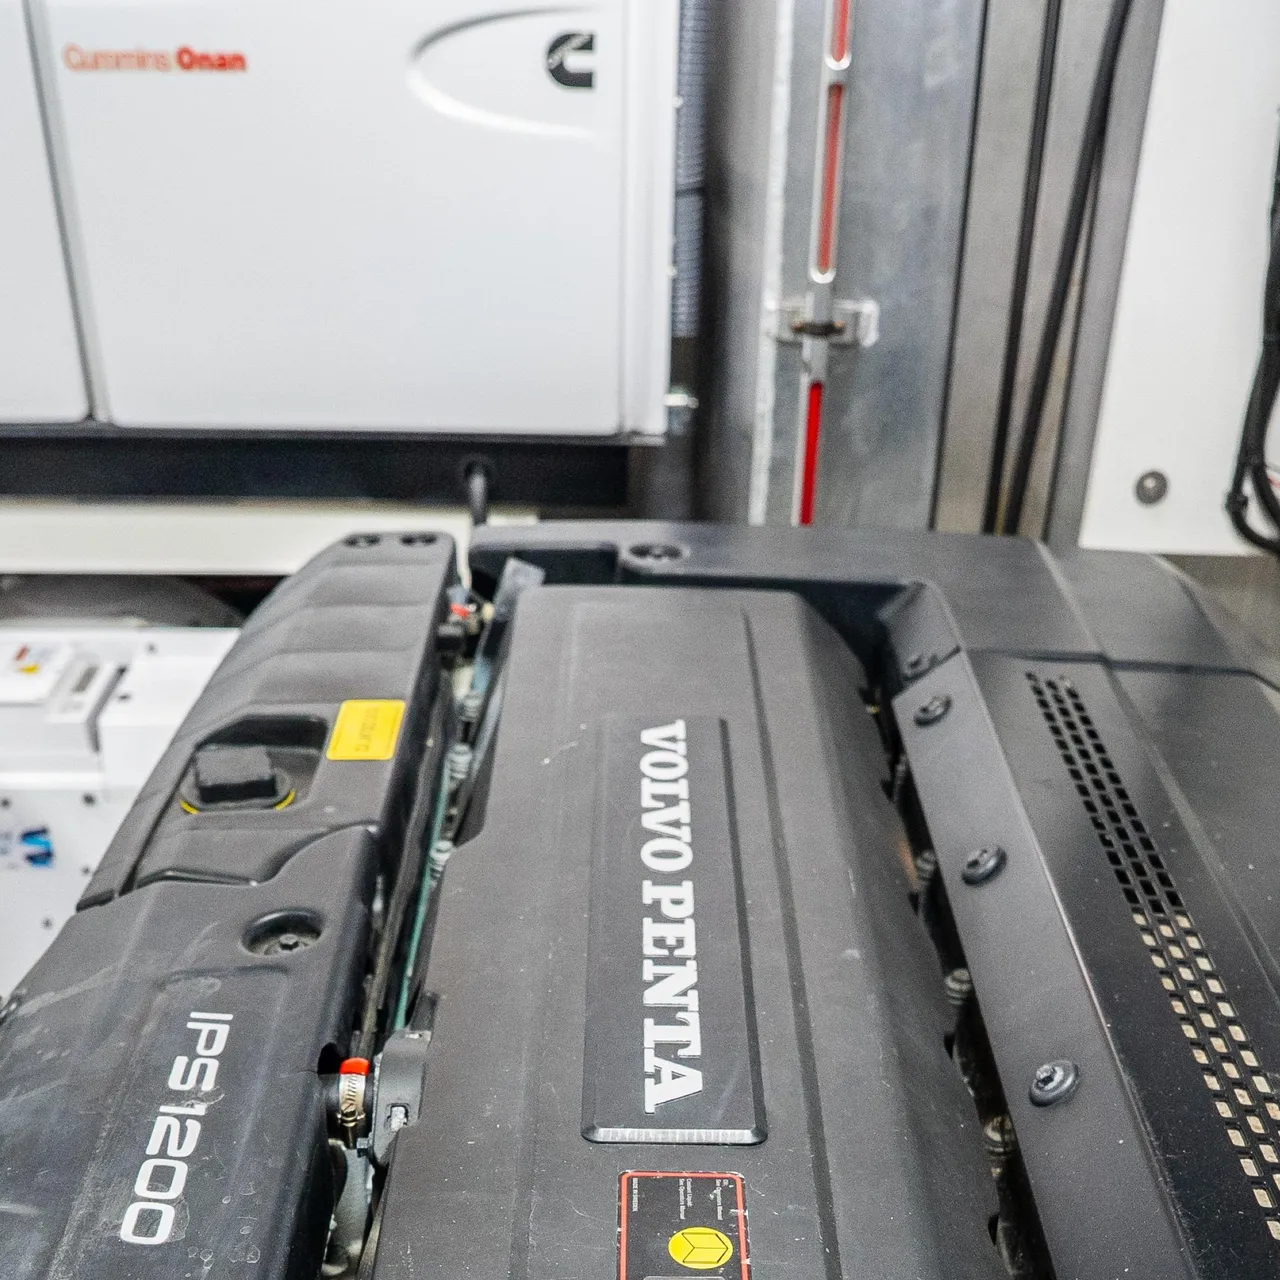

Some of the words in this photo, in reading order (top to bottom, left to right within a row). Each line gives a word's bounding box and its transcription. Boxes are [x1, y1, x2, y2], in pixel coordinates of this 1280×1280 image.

[63, 44, 171, 72] Cummins
[175, 46, 247, 72] Onan
[640, 720, 694, 872] VOLVO
[642, 880, 703, 1114] PENTA
